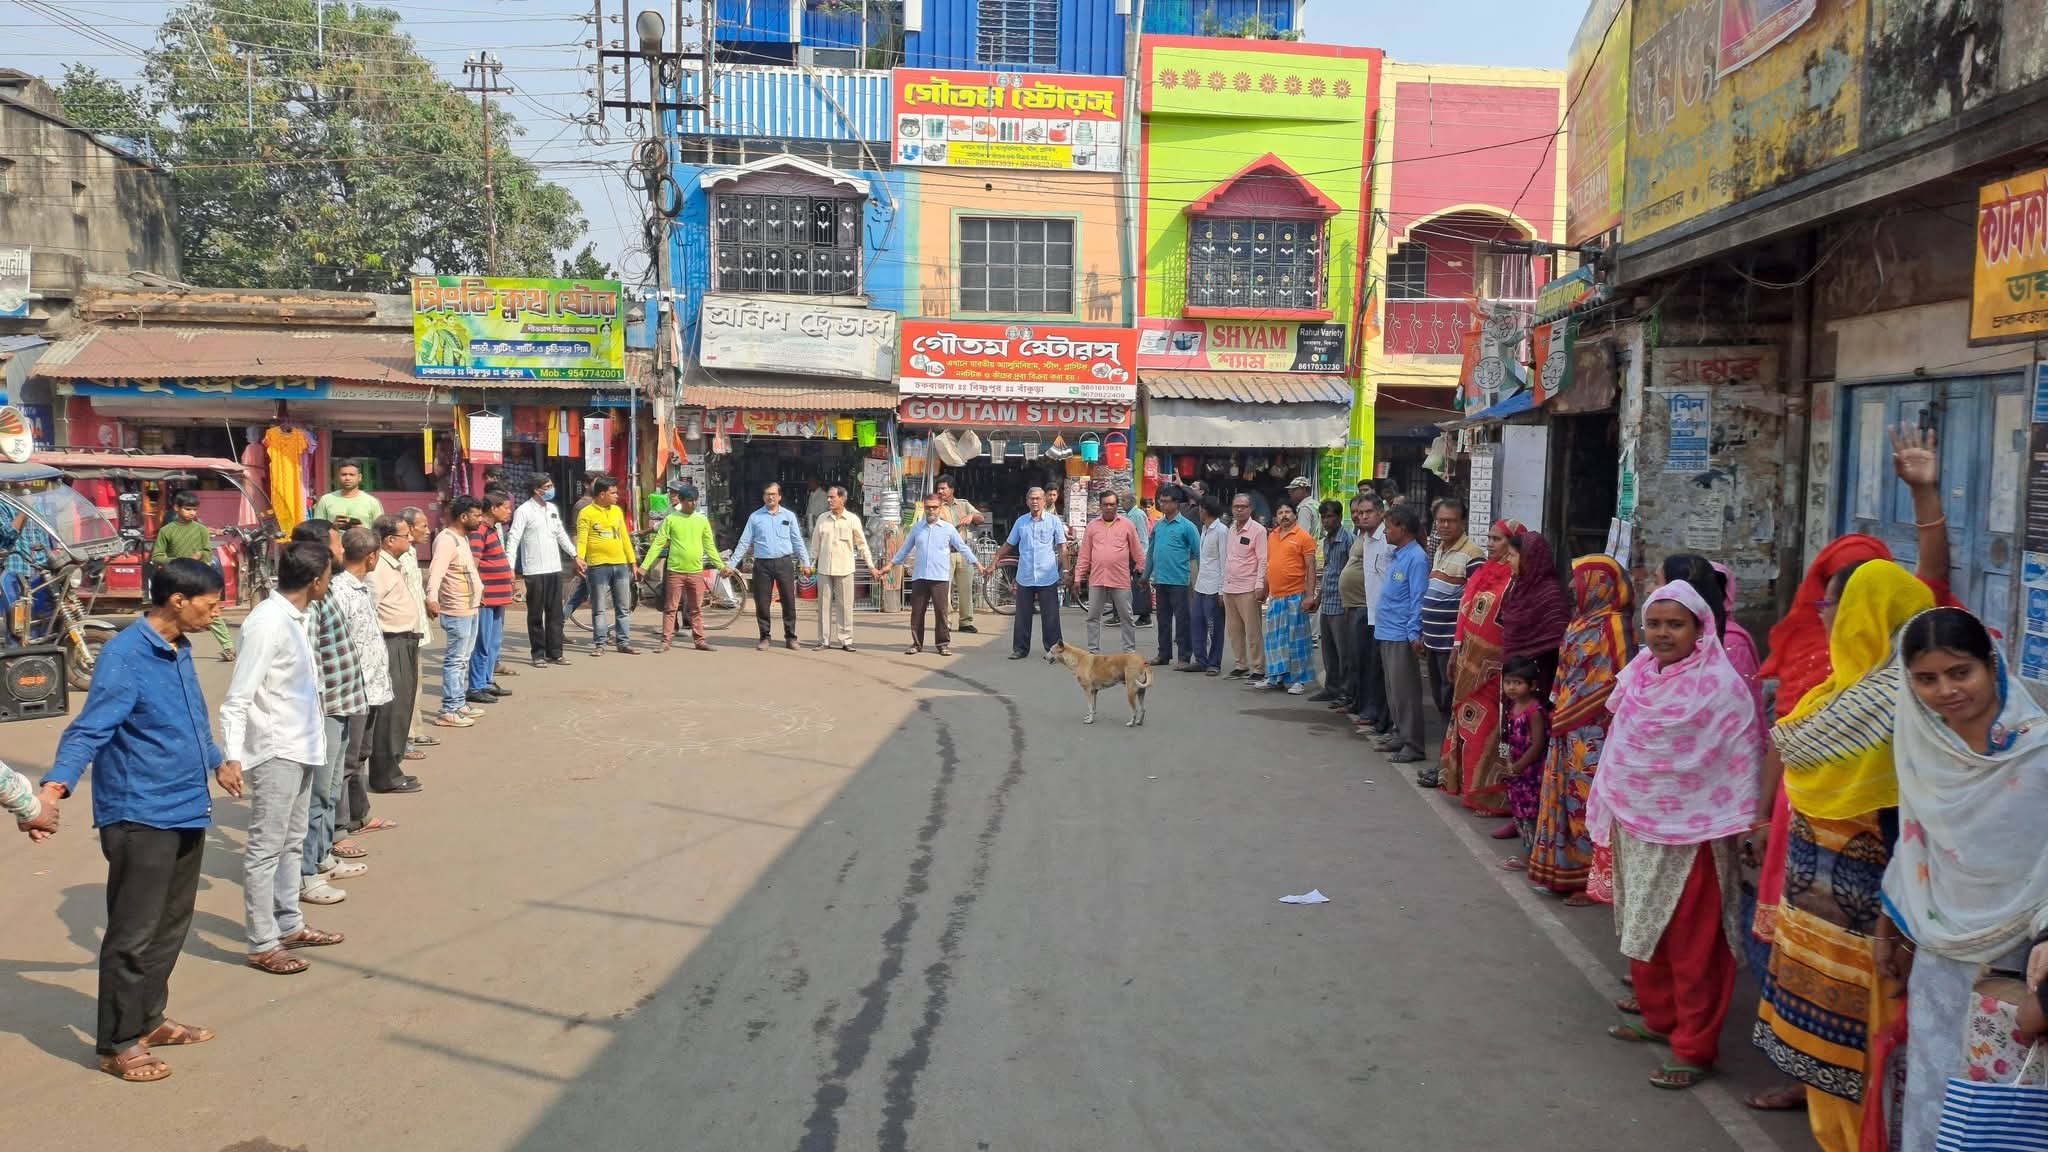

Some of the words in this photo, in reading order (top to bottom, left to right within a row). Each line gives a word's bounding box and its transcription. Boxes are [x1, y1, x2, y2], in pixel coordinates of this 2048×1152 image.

[904, 76, 1004, 109] গৌতম
[1213, 324, 1287, 349] SHYAM
[1300, 328, 1320, 336] Rahul
[1321, 328, 1344, 338] Variety
[912, 331, 1010, 357] গৌতম
[1217, 352, 1266, 368] শ্যাম
[568, 369, 622, 378] 9547742001
[915, 381, 954, 391] চকবাজার
[908, 401, 1018, 423] GOUTAM
[1026, 404, 1127, 425] STORES
